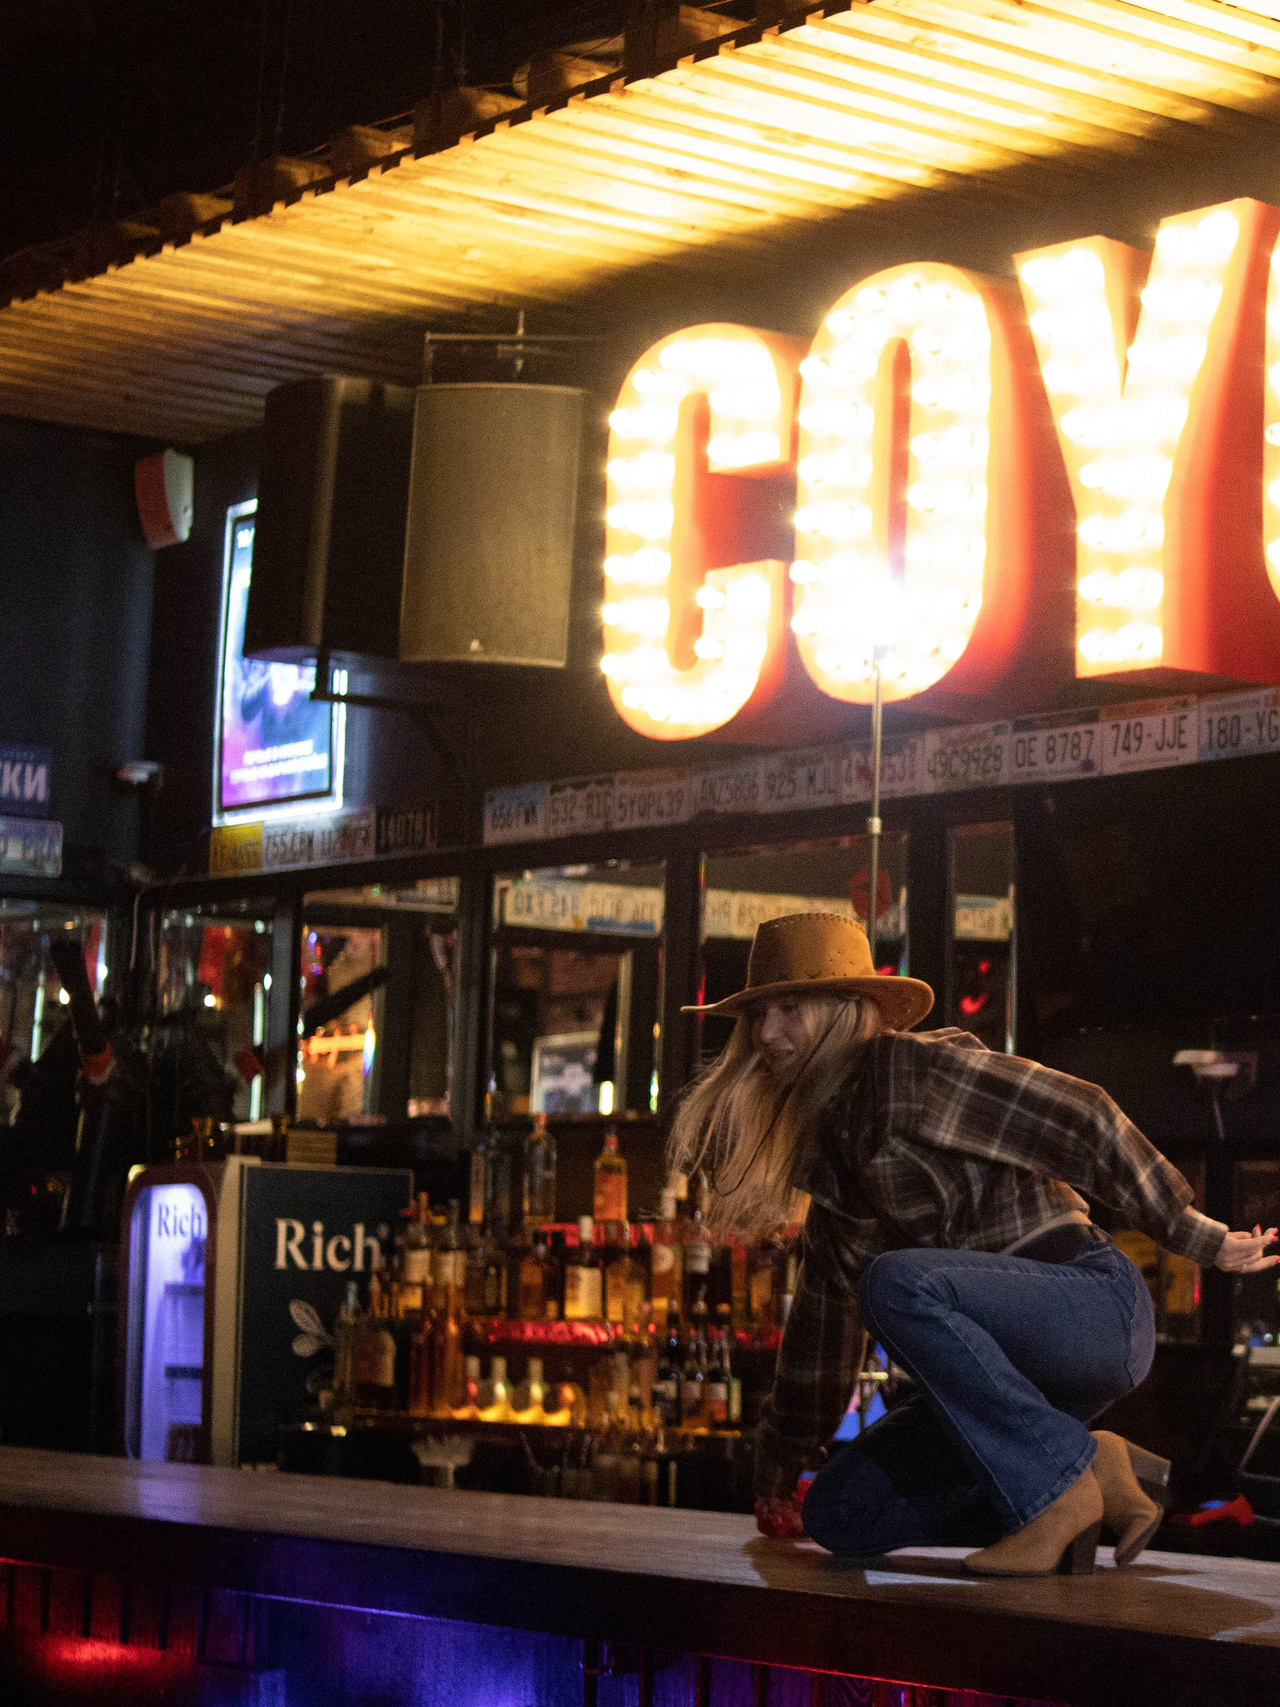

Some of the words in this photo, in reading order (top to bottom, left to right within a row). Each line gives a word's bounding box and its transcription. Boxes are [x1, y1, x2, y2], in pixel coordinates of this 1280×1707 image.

[1045, 729, 1095, 765] 8787
[0, 762, 47, 801] КИ
[157, 1203, 205, 1239] Rich
[274, 1217, 384, 1272] Rich
